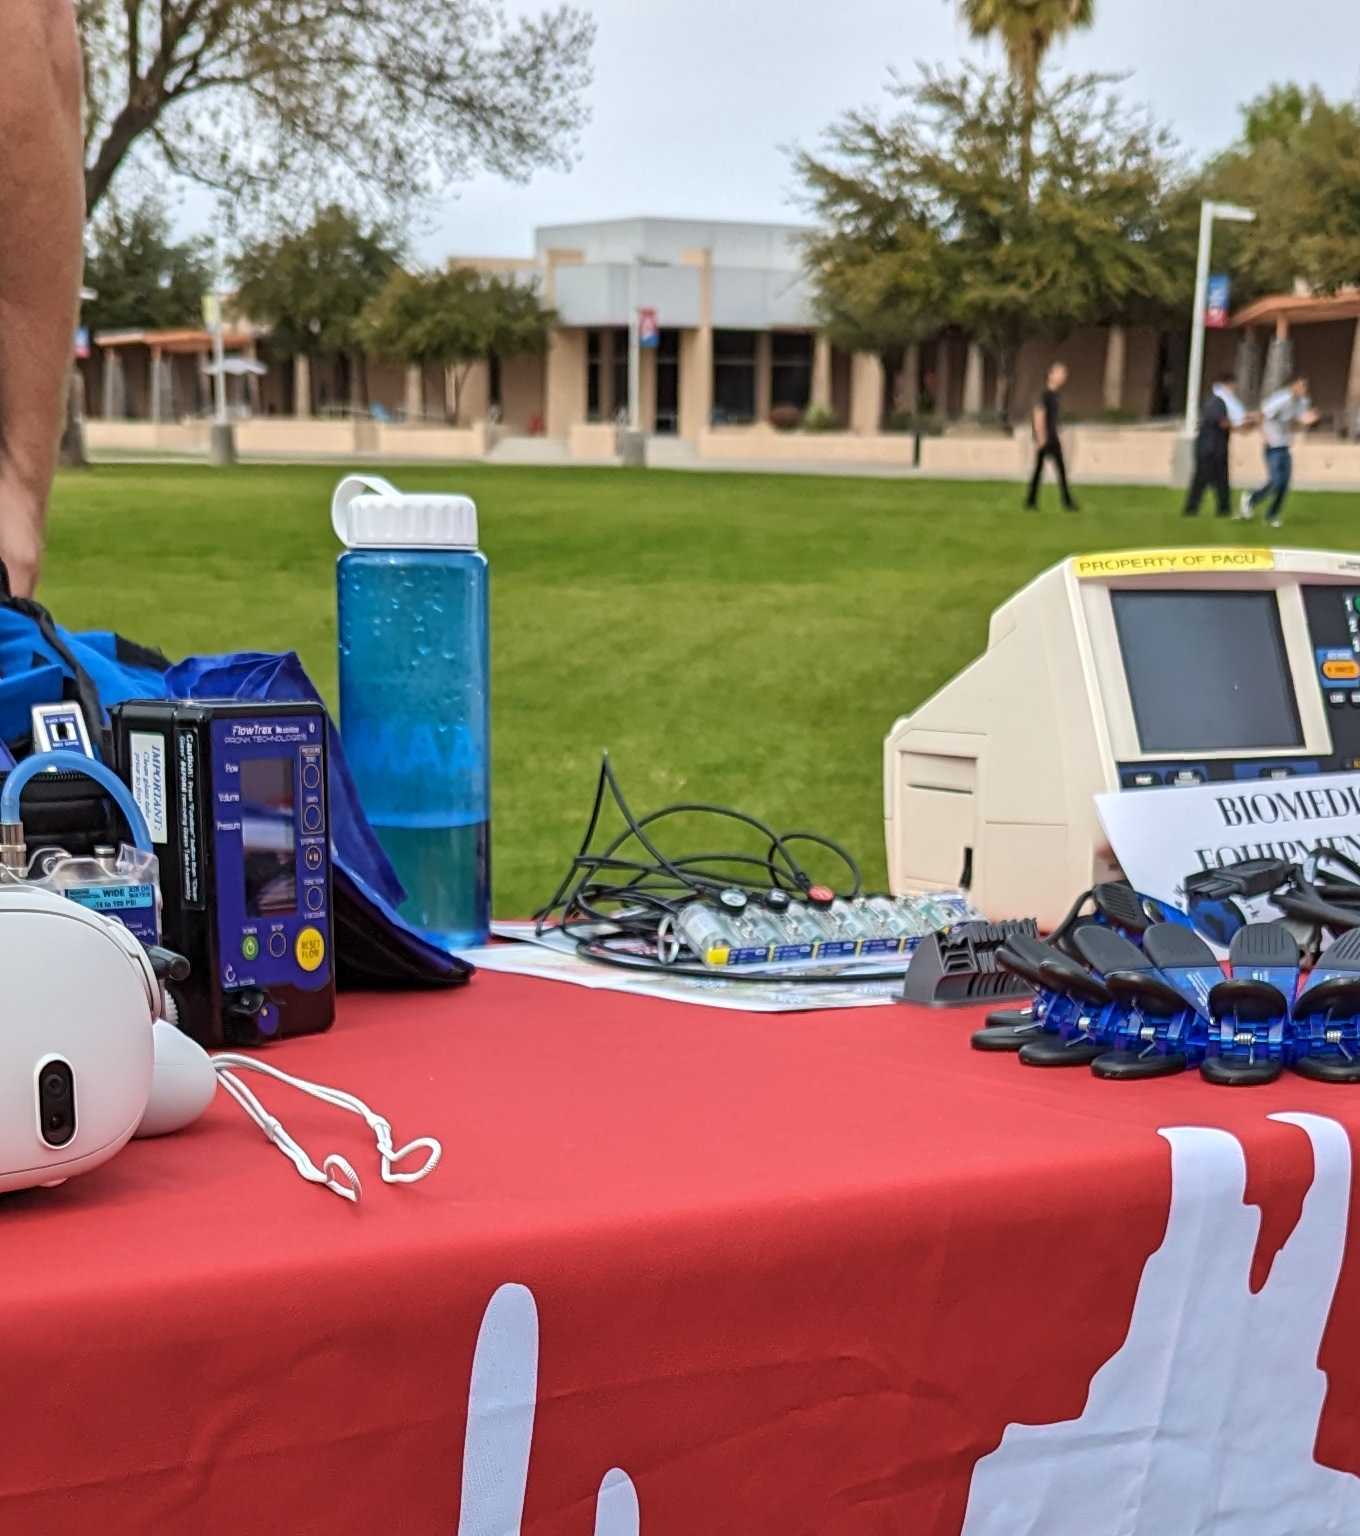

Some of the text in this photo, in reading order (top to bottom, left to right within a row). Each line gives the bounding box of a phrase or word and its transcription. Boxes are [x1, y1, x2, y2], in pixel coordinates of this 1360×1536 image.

[1079, 553, 1256, 572] PROPERTY OF PACU
[232, 725, 273, 736] FlowTrax
[225, 763, 239, 773] Flow
[151, 744, 163, 832] IMPORTANT:
[218, 793, 240, 801] Volume
